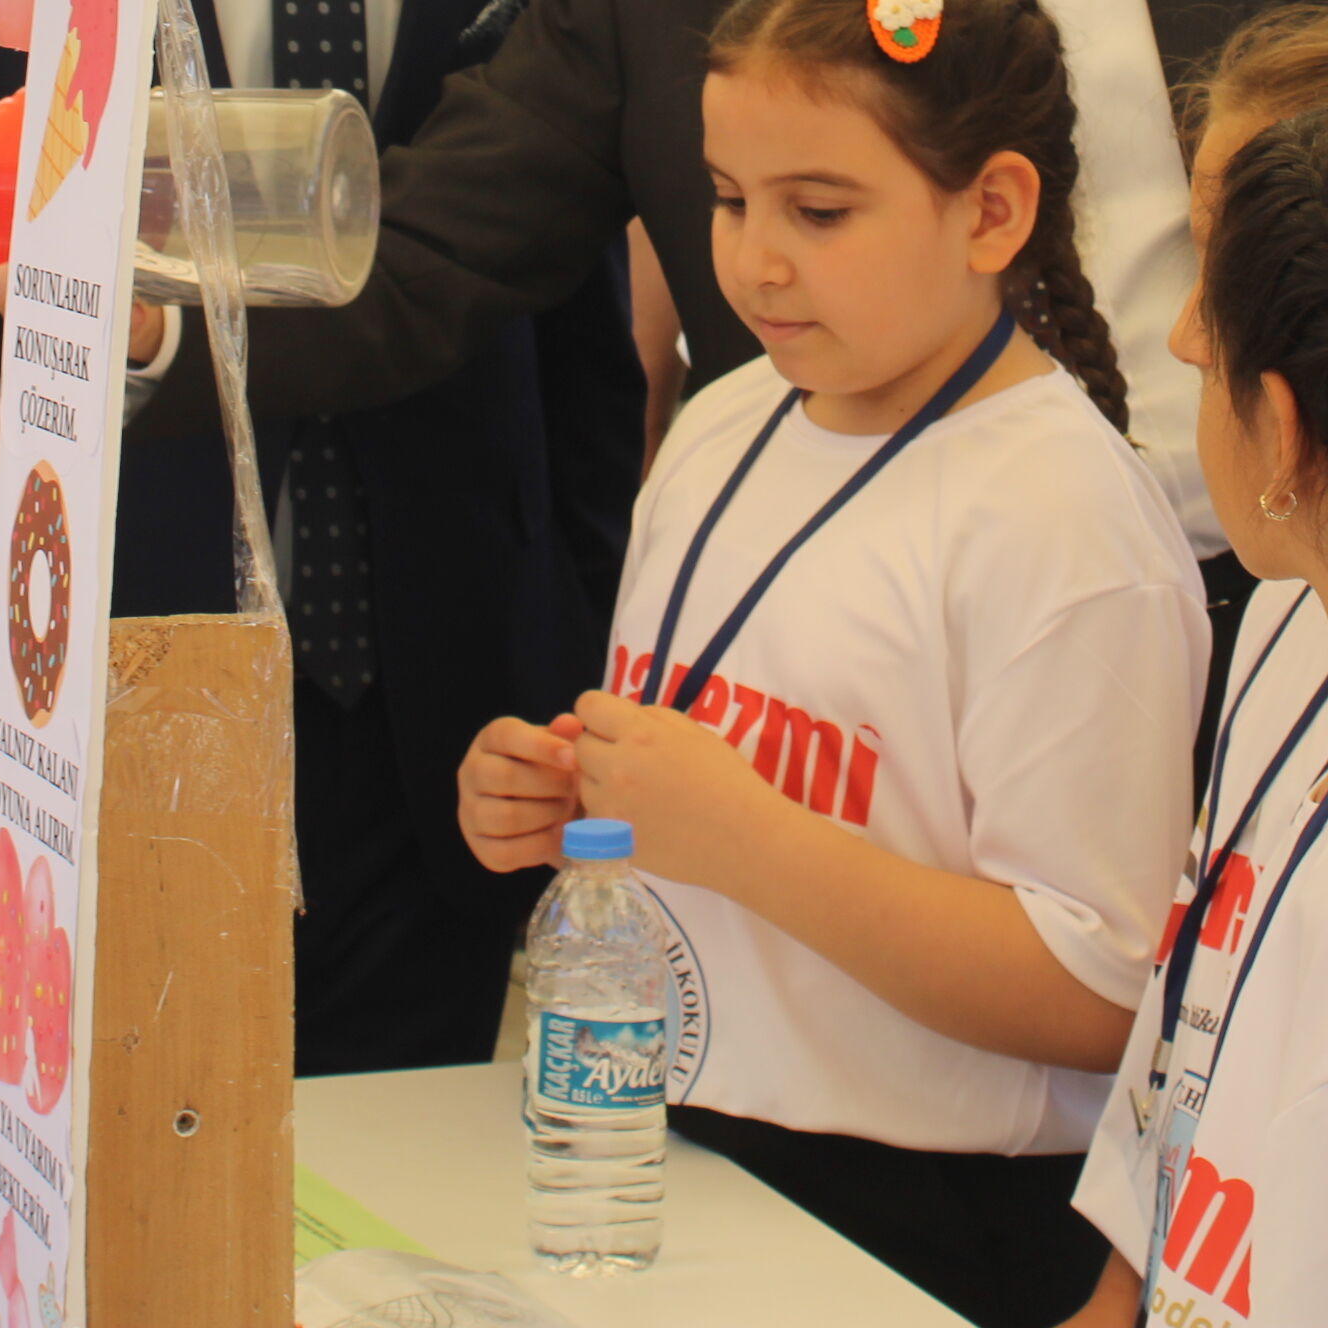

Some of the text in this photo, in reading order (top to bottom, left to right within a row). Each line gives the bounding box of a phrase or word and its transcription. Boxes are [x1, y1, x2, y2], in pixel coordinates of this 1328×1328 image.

[14, 263, 102, 318] SORUNLARIMI
[14, 325, 92, 381] KONUŞARAK
[19, 384, 77, 442] ÇÖZERİM.
[37, 742, 79, 801] KALANI
[544, 1018, 580, 1100] KAÇKAR
[16, 1116, 58, 1191] UYARIM
